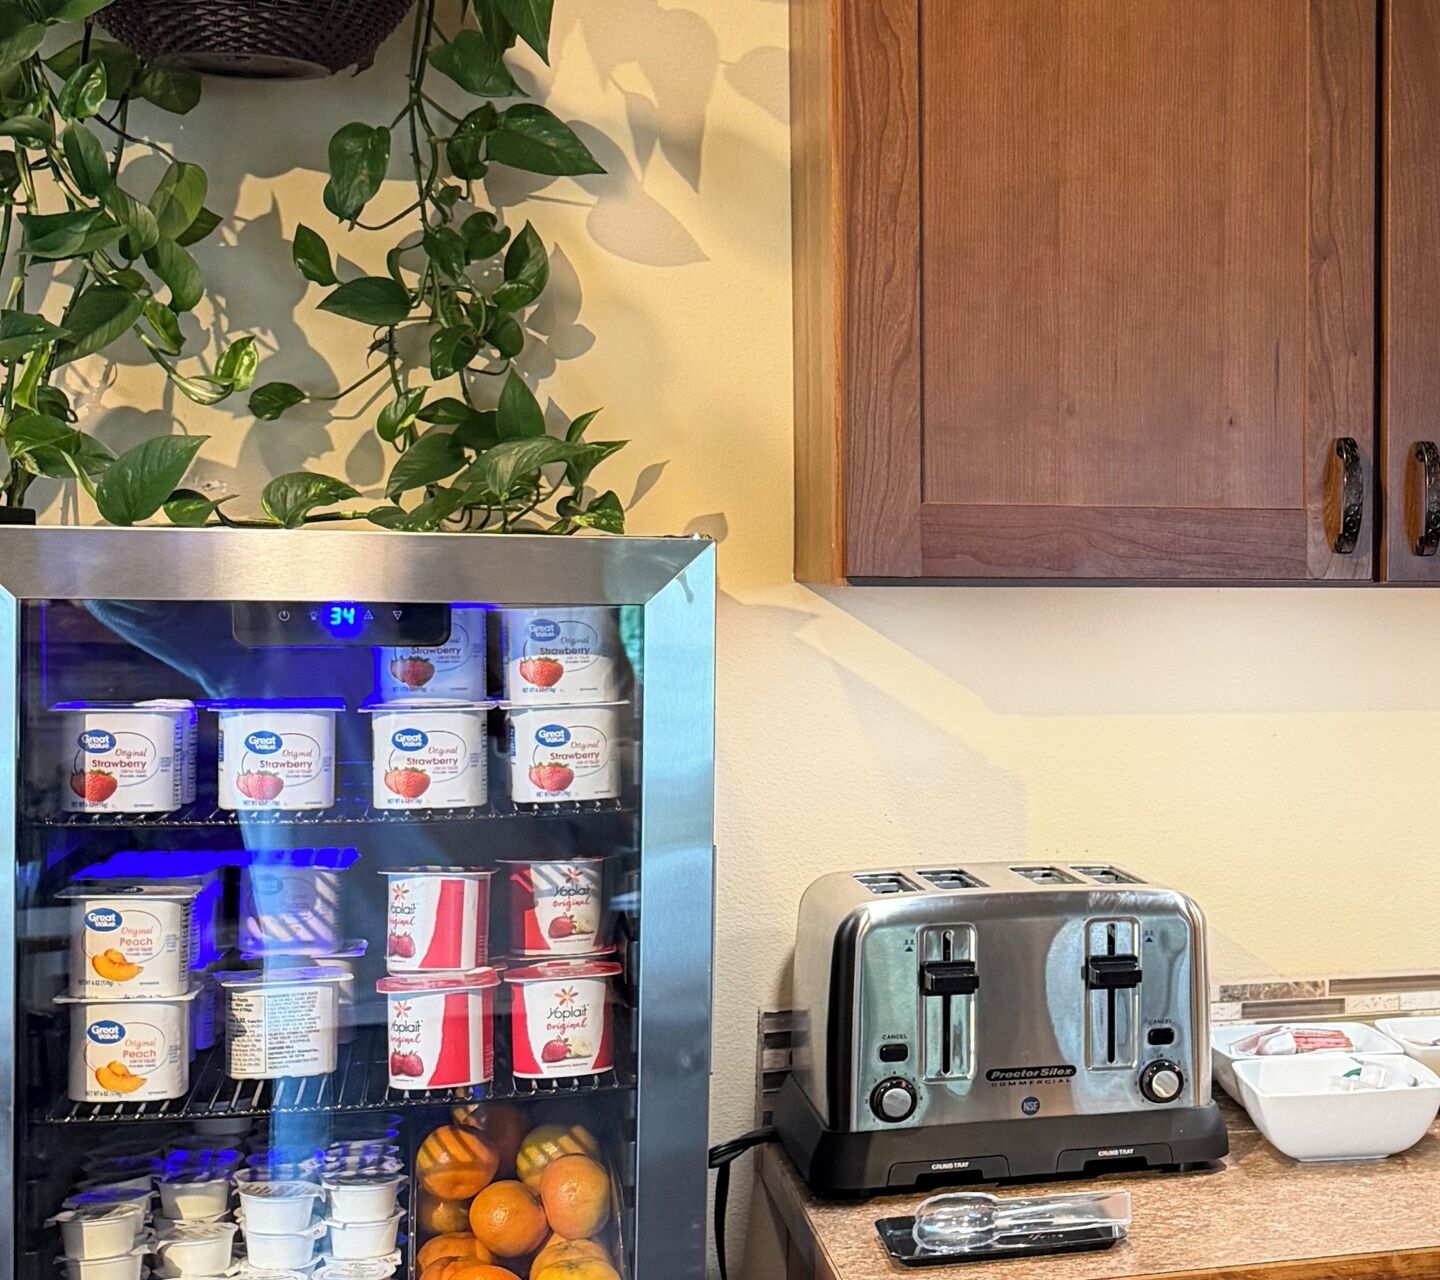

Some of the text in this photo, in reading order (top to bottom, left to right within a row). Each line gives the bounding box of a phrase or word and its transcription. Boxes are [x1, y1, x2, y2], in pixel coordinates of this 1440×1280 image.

[330, 607, 355, 625] 34
[529, 624, 555, 632] Great
[561, 636, 590, 646] Original
[411, 646, 461, 656] Strawberry
[540, 647, 590, 655] Strawberry
[81, 734, 110, 744] Great
[395, 733, 423, 742] Great
[538, 730, 565, 738] Great
[248, 735, 276, 744] Great
[571, 740, 600, 751] Original
[115, 748, 147, 759] Original
[282, 749, 313, 760] Original
[428, 746, 458, 757] Original
[550, 752, 600, 760] Strawberry
[92, 759, 147, 769] Strawberry
[260, 760, 313, 769] Strawberry
[406, 757, 458, 766] Strawberry
[554, 885, 591, 899] Yoplait
[391, 902, 416, 917] oplait
[88, 913, 115, 921] Great
[121, 926, 153, 936] Original
[120, 938, 153, 946] Peach
[547, 1004, 587, 1022] Yoplait
[91, 1026, 119, 1034] Great
[125, 1038, 156, 1049] Original
[123, 1050, 156, 1058] Peach
[1023, 1101, 1039, 1111] NSF
[931, 1162, 953, 1170] CRUMB
